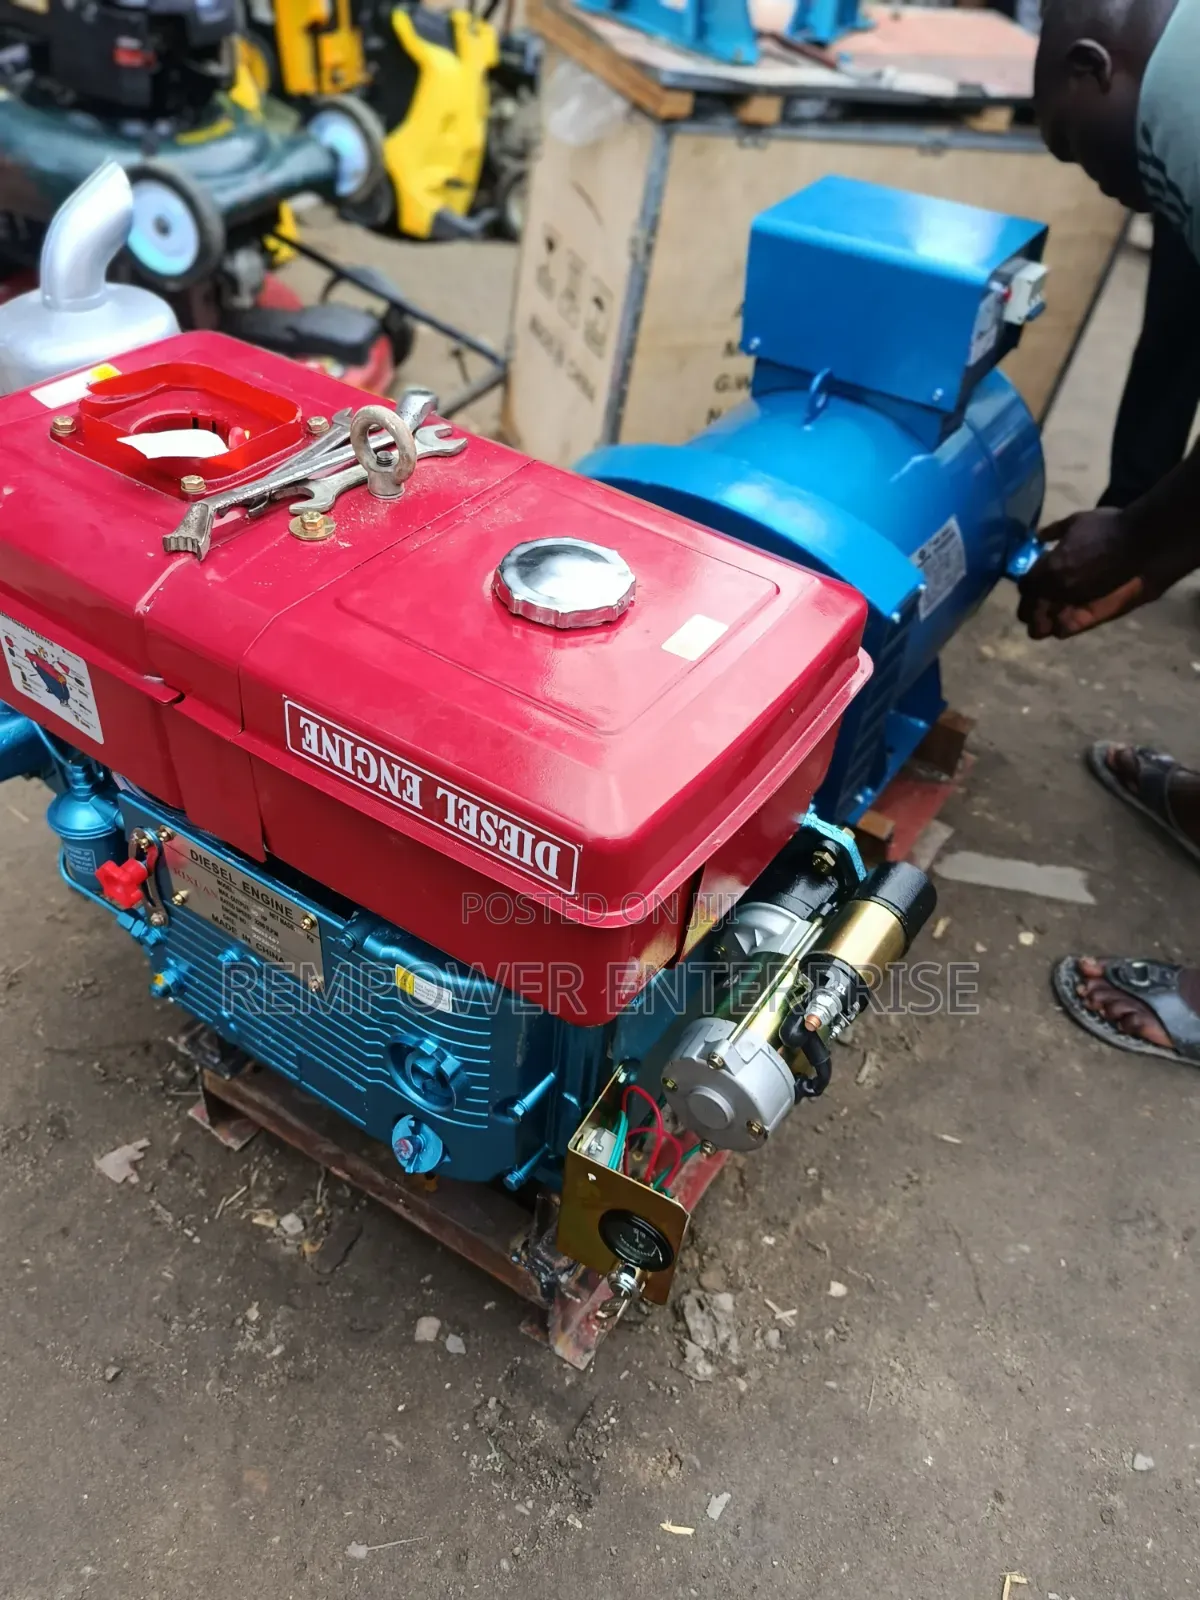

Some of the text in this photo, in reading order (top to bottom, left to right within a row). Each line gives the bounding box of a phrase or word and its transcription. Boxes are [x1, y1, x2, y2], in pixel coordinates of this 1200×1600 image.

[299, 715, 561, 880] DIESEL ENGINE
[190, 849, 237, 886] DIESEL
[242, 881, 293, 920] ENGINE
[211, 912, 238, 935] MADE
[242, 933, 251, 944] IN
[256, 942, 285, 963] CHINA
